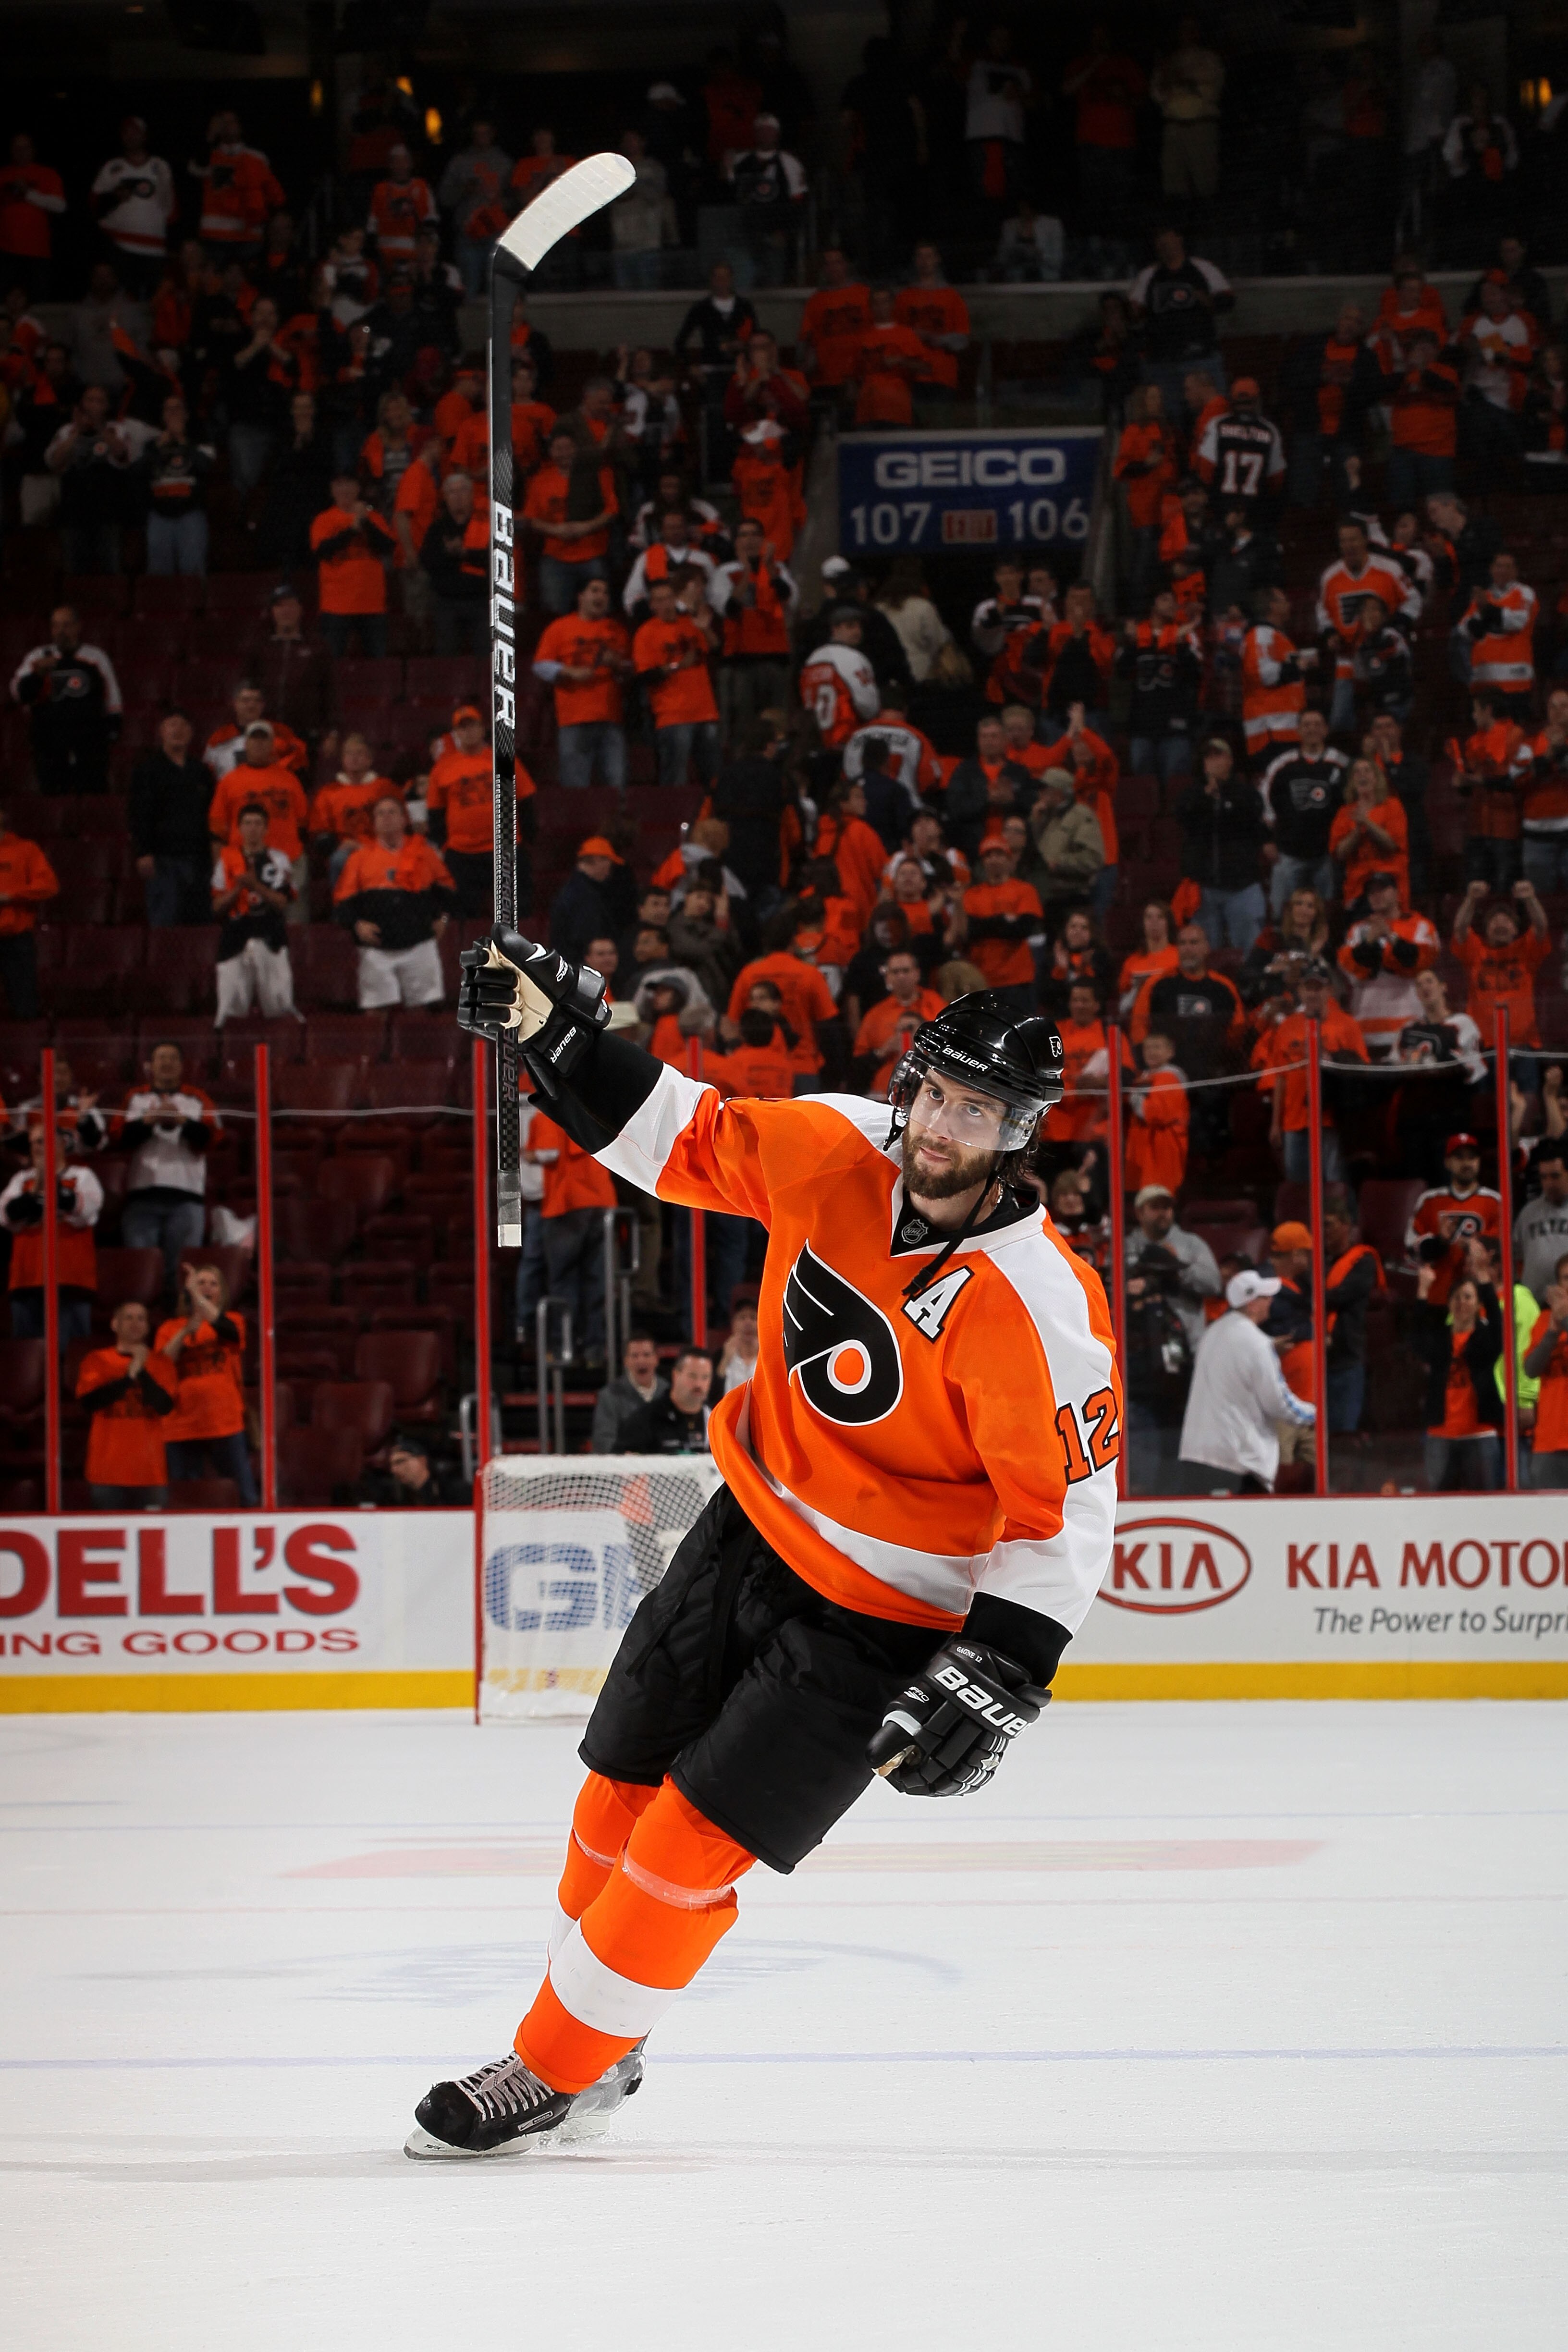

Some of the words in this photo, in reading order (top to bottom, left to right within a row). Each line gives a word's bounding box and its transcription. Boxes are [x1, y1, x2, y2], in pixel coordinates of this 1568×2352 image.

[874, 447, 1066, 489] GEICO
[1220, 450, 1265, 495] 17
[850, 501, 932, 545] 107
[1009, 498, 1090, 542] 106
[494, 501, 515, 730] BAUER
[502, 1028, 515, 1103] AUER
[550, 1026, 577, 1064] BAUER
[942, 1046, 989, 1072] BAUER
[900, 1265, 975, 1344] A
[1054, 1386, 1120, 1486] 12
[0, 1523, 360, 1618] DELL'S
[1113, 1543, 1222, 1589] KIA
[1287, 1543, 1380, 1589] KIA
[1399, 1539, 1568, 1590] MOTO
[1313, 1606, 1363, 1633] The
[1370, 1606, 1454, 1633] Power
[1459, 1608, 1487, 1632] to
[122, 1629, 359, 1656] GOODS
[956, 1646, 976, 1659] GAGNE
[975, 1655, 983, 1664] 12
[933, 1665, 1032, 1738] BAUE
